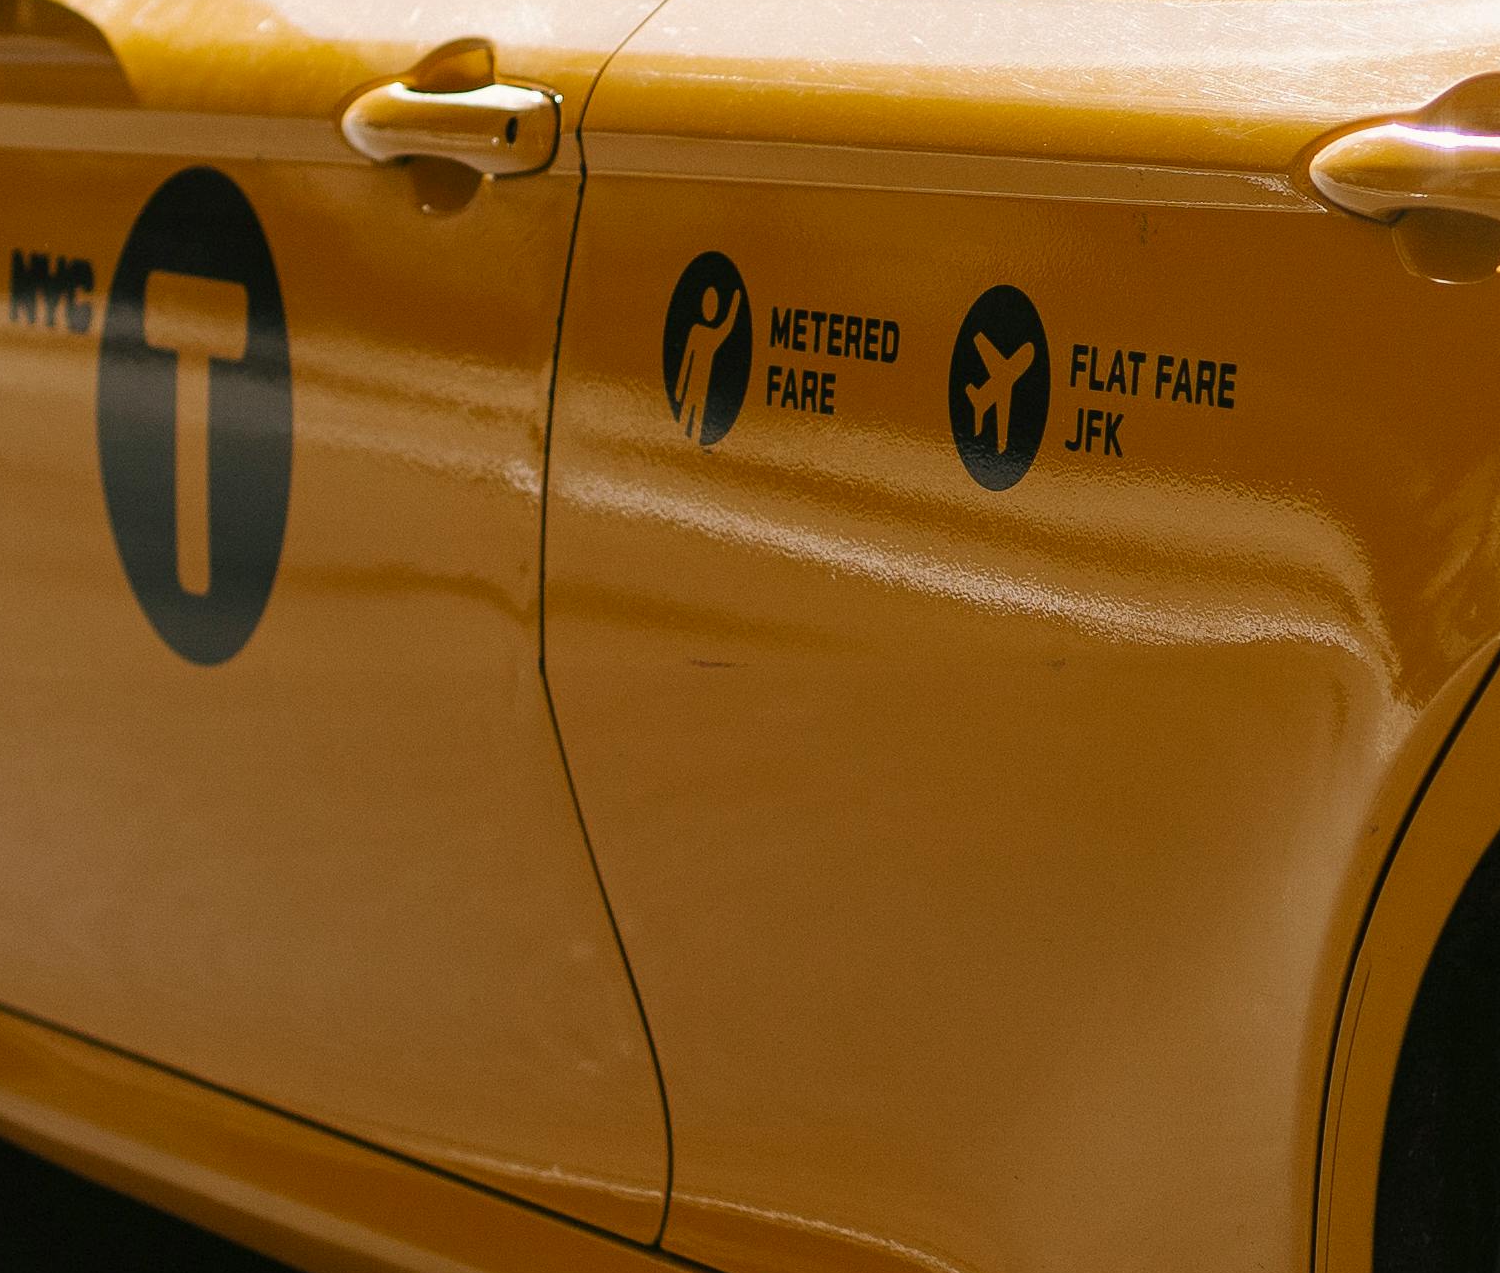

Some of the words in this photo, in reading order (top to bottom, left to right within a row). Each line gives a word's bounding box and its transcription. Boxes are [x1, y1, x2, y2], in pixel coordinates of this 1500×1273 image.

[9, 248, 94, 335] NYC
[769, 306, 900, 364] METERED
[766, 365, 836, 415] FARE
[1070, 343, 1147, 396] FLAT
[1155, 354, 1237, 409] FARE
[1065, 407, 1124, 458] JFK
